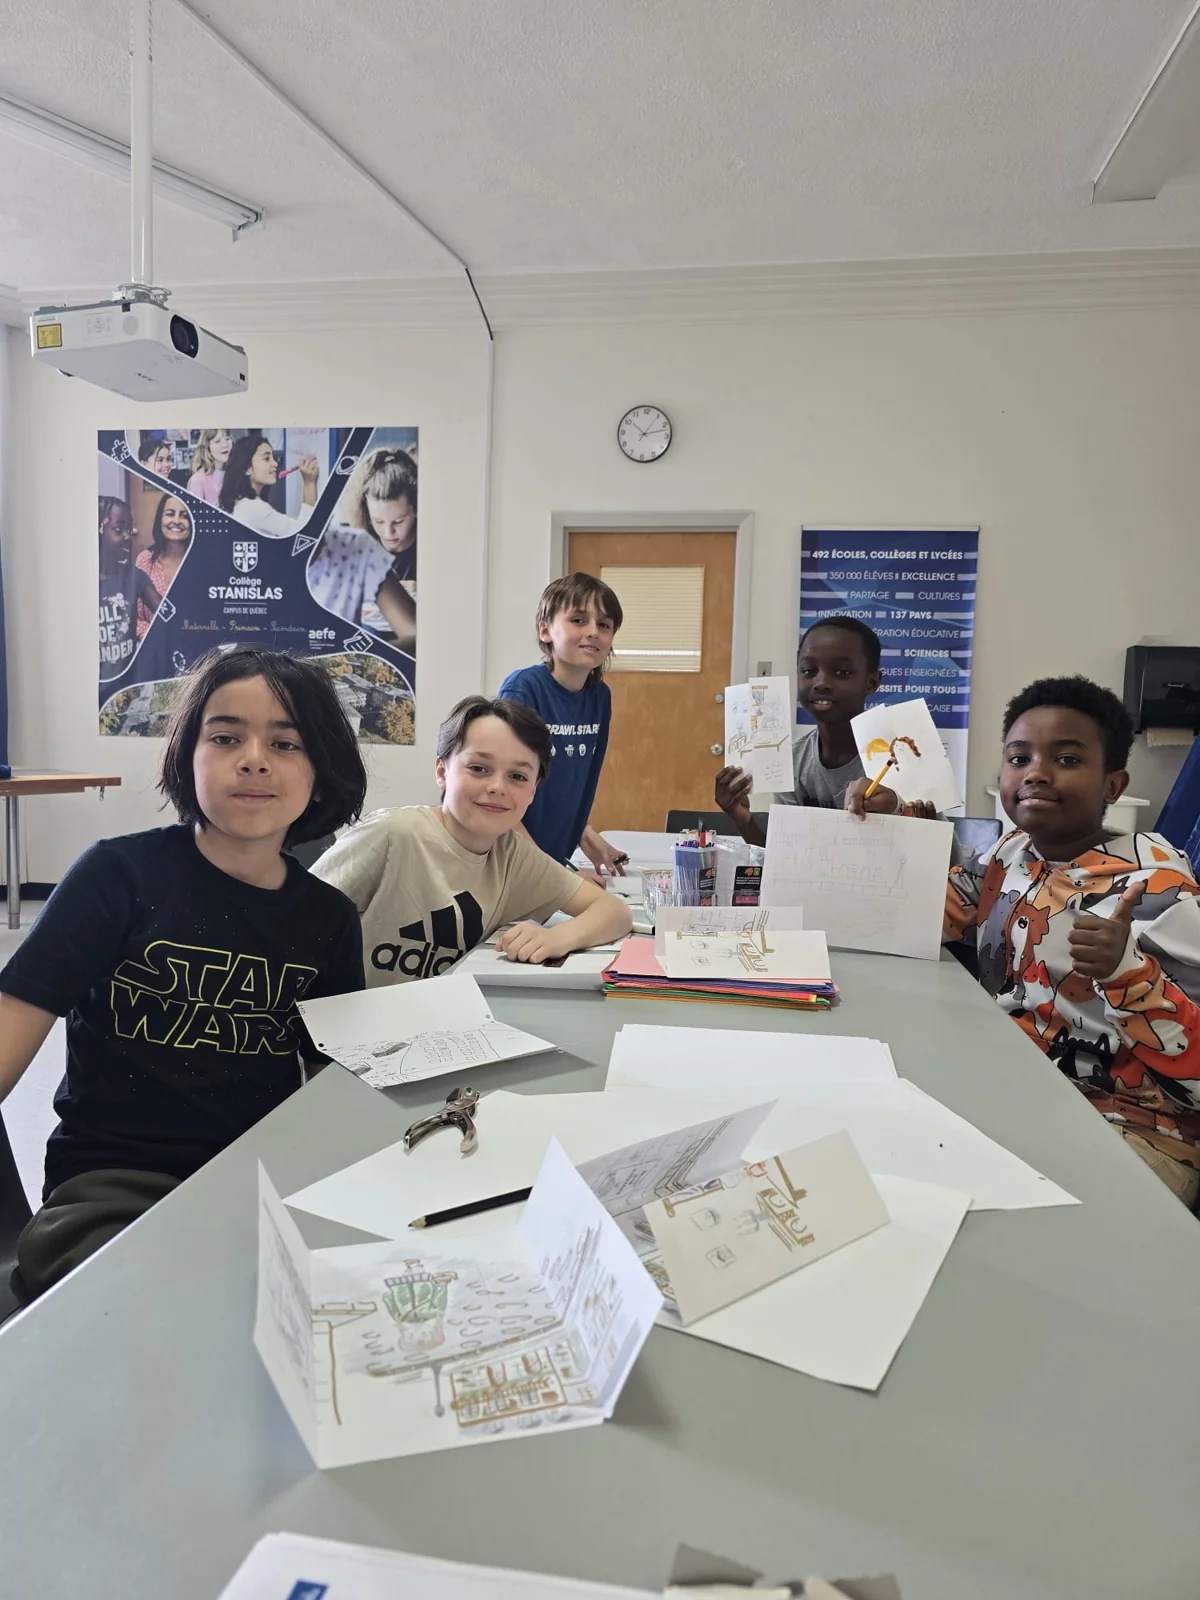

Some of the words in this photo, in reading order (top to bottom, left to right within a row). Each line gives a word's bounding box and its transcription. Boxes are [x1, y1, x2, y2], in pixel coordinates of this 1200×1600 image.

[812, 550, 830, 559] 492
[832, 549, 868, 560] ÉCOLES,
[870, 549, 917, 560] COLLÈGES
[918, 551, 929, 559] ET
[931, 549, 963, 560] LYCÉES
[829, 571, 845, 580] 350
[846, 571, 862, 580] 000
[863, 570, 894, 580] ÉLÈVES
[901, 572, 956, 581] EXCELLENCE
[229, 576, 262, 588] Collège
[208, 587, 283, 600] STANISLAS
[850, 591, 890, 599] PARTAGE
[918, 592, 961, 600] CULTURES
[249, 606, 267, 615] QUÉBEC
[818, 610, 872, 619] INNOVATION
[890, 611, 906, 619] 137
[909, 611, 932, 619] PAYS
[229, 620, 261, 631] Primaire
[308, 627, 336, 640] aefe
[911, 628, 960, 639] ÉDUCATIVE
[904, 649, 949, 658] SCIENCES
[904, 667, 956, 677] ENSEIGNÉES
[905, 685, 931, 694] POUR
[932, 685, 957, 694] TOUS
[114, 940, 319, 1012] STAR
[111, 980, 301, 1055] WARS
